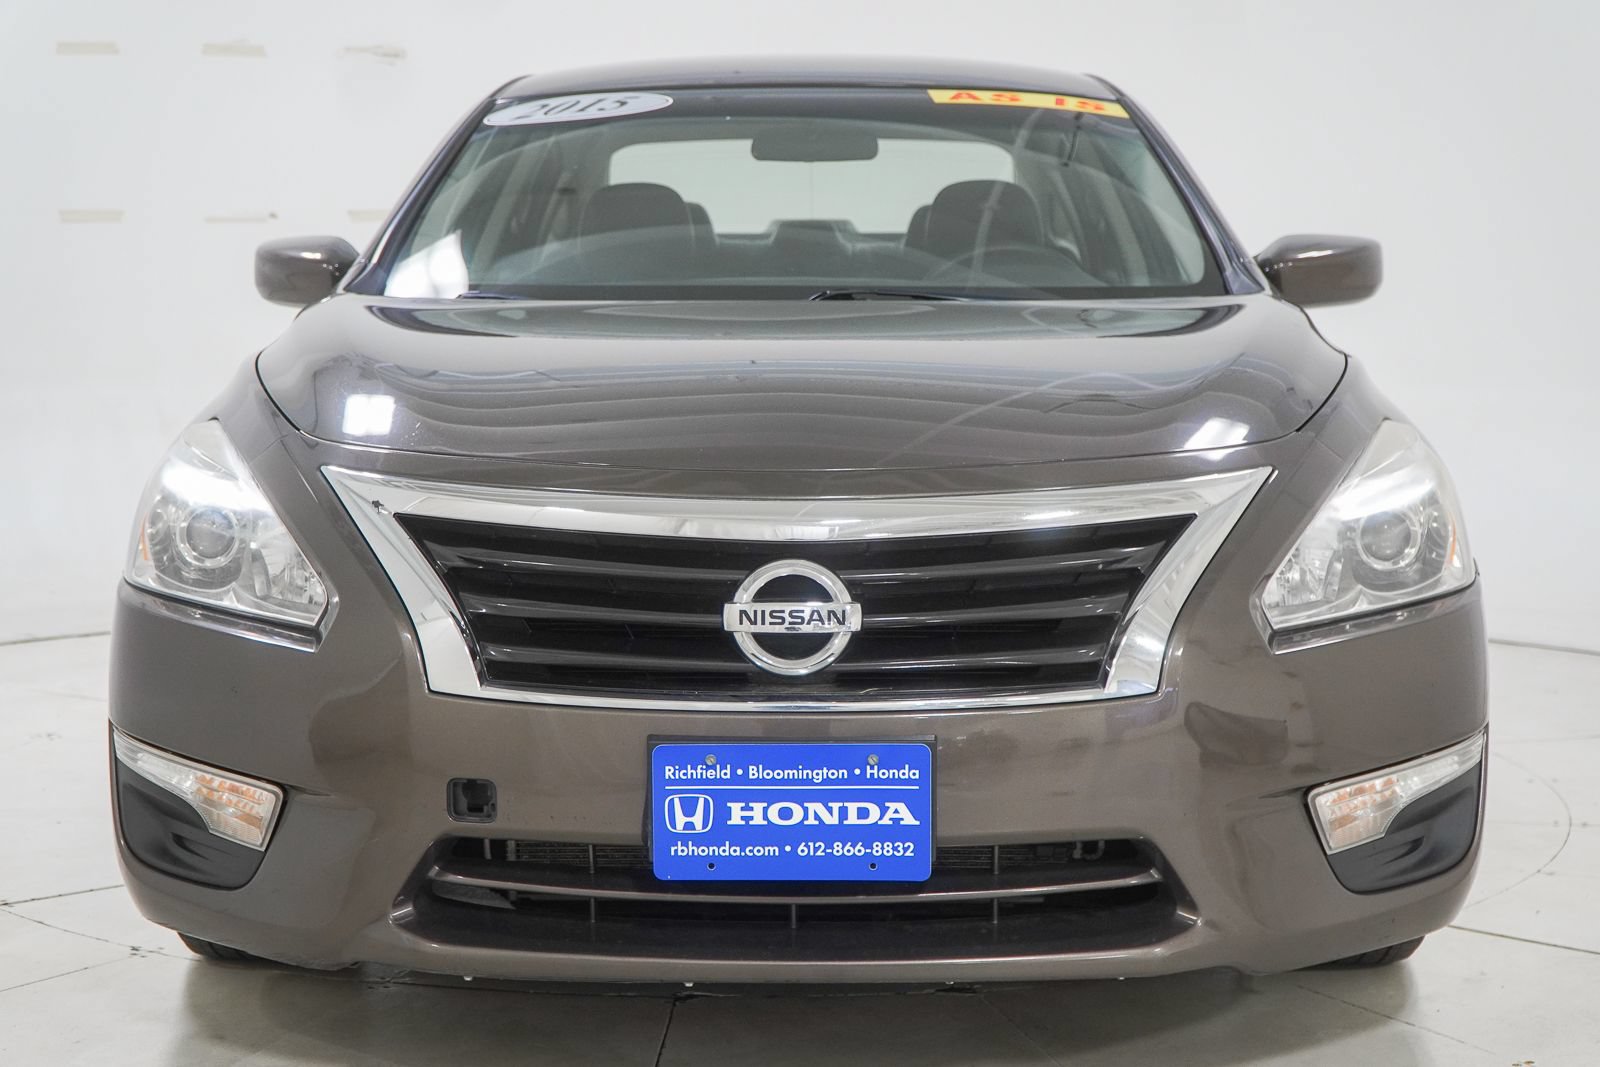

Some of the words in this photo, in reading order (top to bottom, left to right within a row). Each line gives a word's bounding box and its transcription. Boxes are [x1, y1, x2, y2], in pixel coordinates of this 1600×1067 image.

[511, 95, 641, 121] 2015
[950, 91, 1023, 103] AS
[1055, 97, 1105, 111] IS
[738, 609, 846, 626] NISSAN
[665, 765, 731, 780] Richfield
[748, 765, 848, 783] Bloomington
[866, 764, 920, 780] Honda
[727, 801, 921, 826] HONDA
[670, 841, 780, 857] rbhonda.com
[797, 841, 915, 857] 612-866-8832
